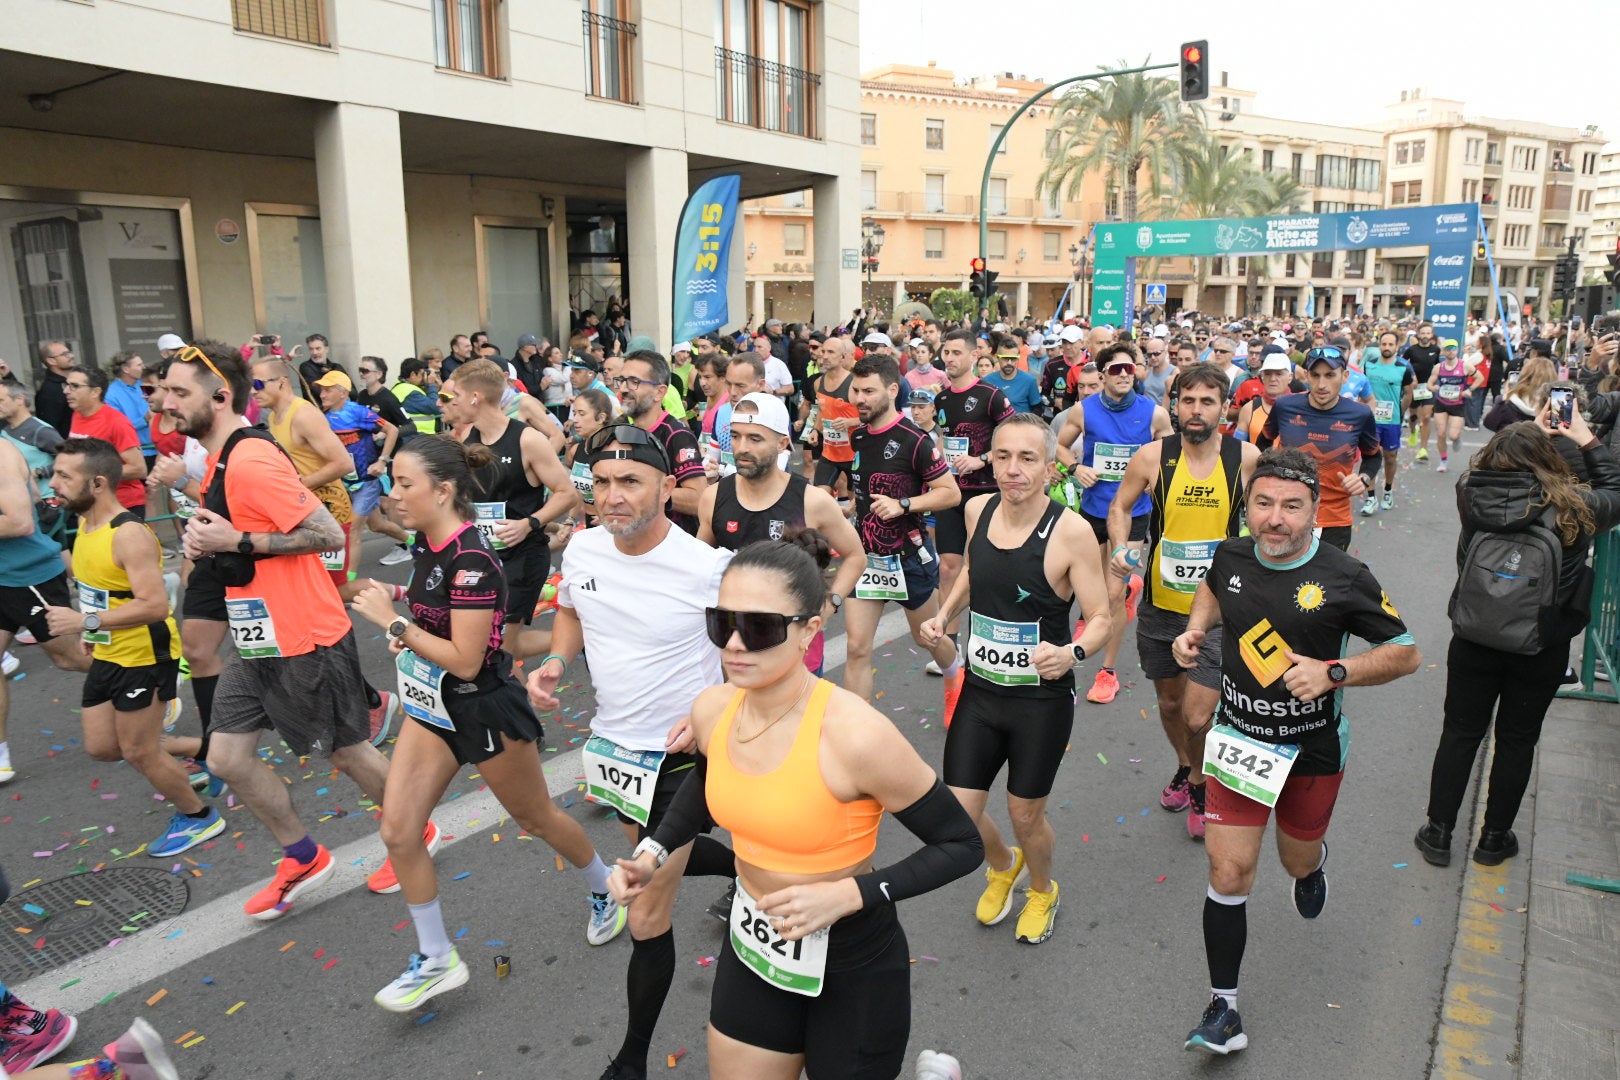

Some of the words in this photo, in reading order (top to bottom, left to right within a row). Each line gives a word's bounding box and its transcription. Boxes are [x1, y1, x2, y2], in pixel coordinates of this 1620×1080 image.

[695, 203, 723, 273] 3:15
[1265, 237, 1319, 249] Alicante
[1266, 230, 1300, 240] Elche
[1104, 460, 1129, 471] 332
[1183, 485, 1215, 497] USY
[861, 573, 899, 588] 2090
[1175, 565, 1208, 579] 872
[974, 645, 1030, 668] 4048
[403, 681, 436, 710] 2887
[1222, 674, 1328, 717] Ginestar
[1217, 742, 1274, 780] 1342
[597, 763, 642, 796] 1071
